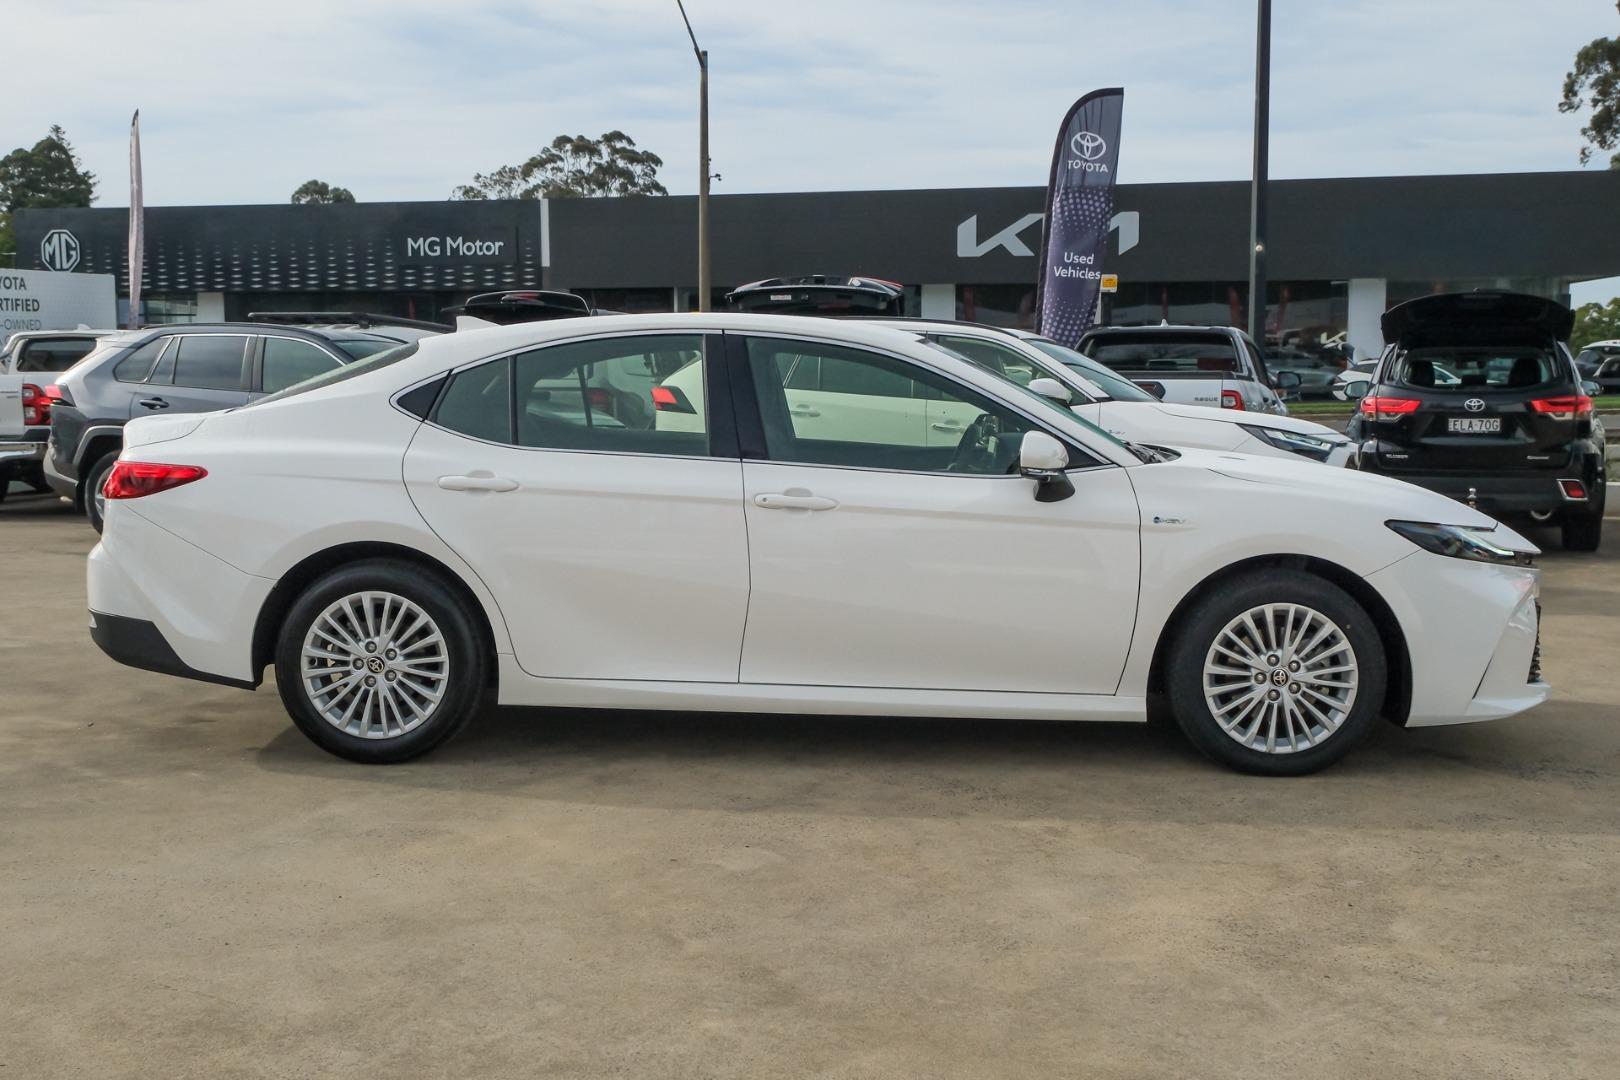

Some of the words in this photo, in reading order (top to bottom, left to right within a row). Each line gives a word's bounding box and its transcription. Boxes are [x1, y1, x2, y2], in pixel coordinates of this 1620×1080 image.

[1068, 160, 1108, 173] TOYOTA
[957, 211, 1140, 257] KA
[44, 232, 78, 270] MG
[407, 236, 441, 257] MG
[446, 236, 504, 256] Motor
[1064, 251, 1095, 265] Used
[1053, 265, 1101, 280] Vehicles
